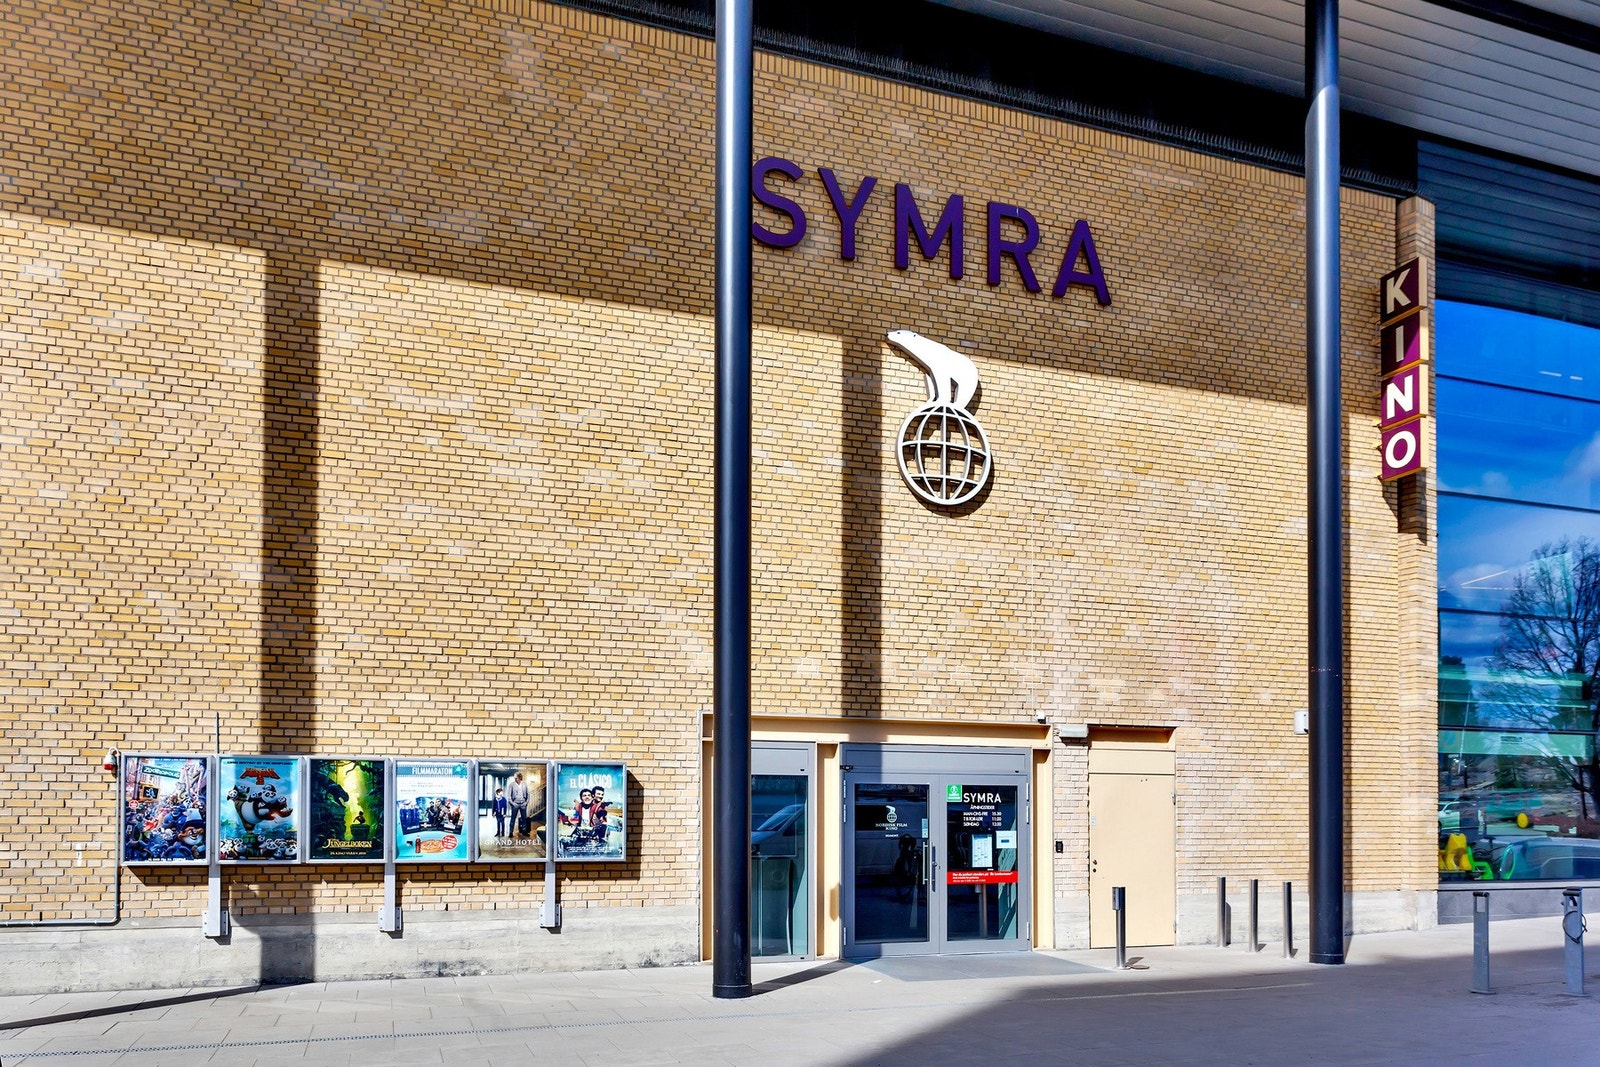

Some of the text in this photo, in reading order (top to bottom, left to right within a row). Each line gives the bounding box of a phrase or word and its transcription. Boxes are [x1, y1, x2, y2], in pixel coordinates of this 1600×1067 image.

[751, 156, 1112, 306] SYMRA
[1385, 267, 1417, 469] KINO
[570, 779, 577, 788] EL
[963, 793, 1001, 803] SYMRA
